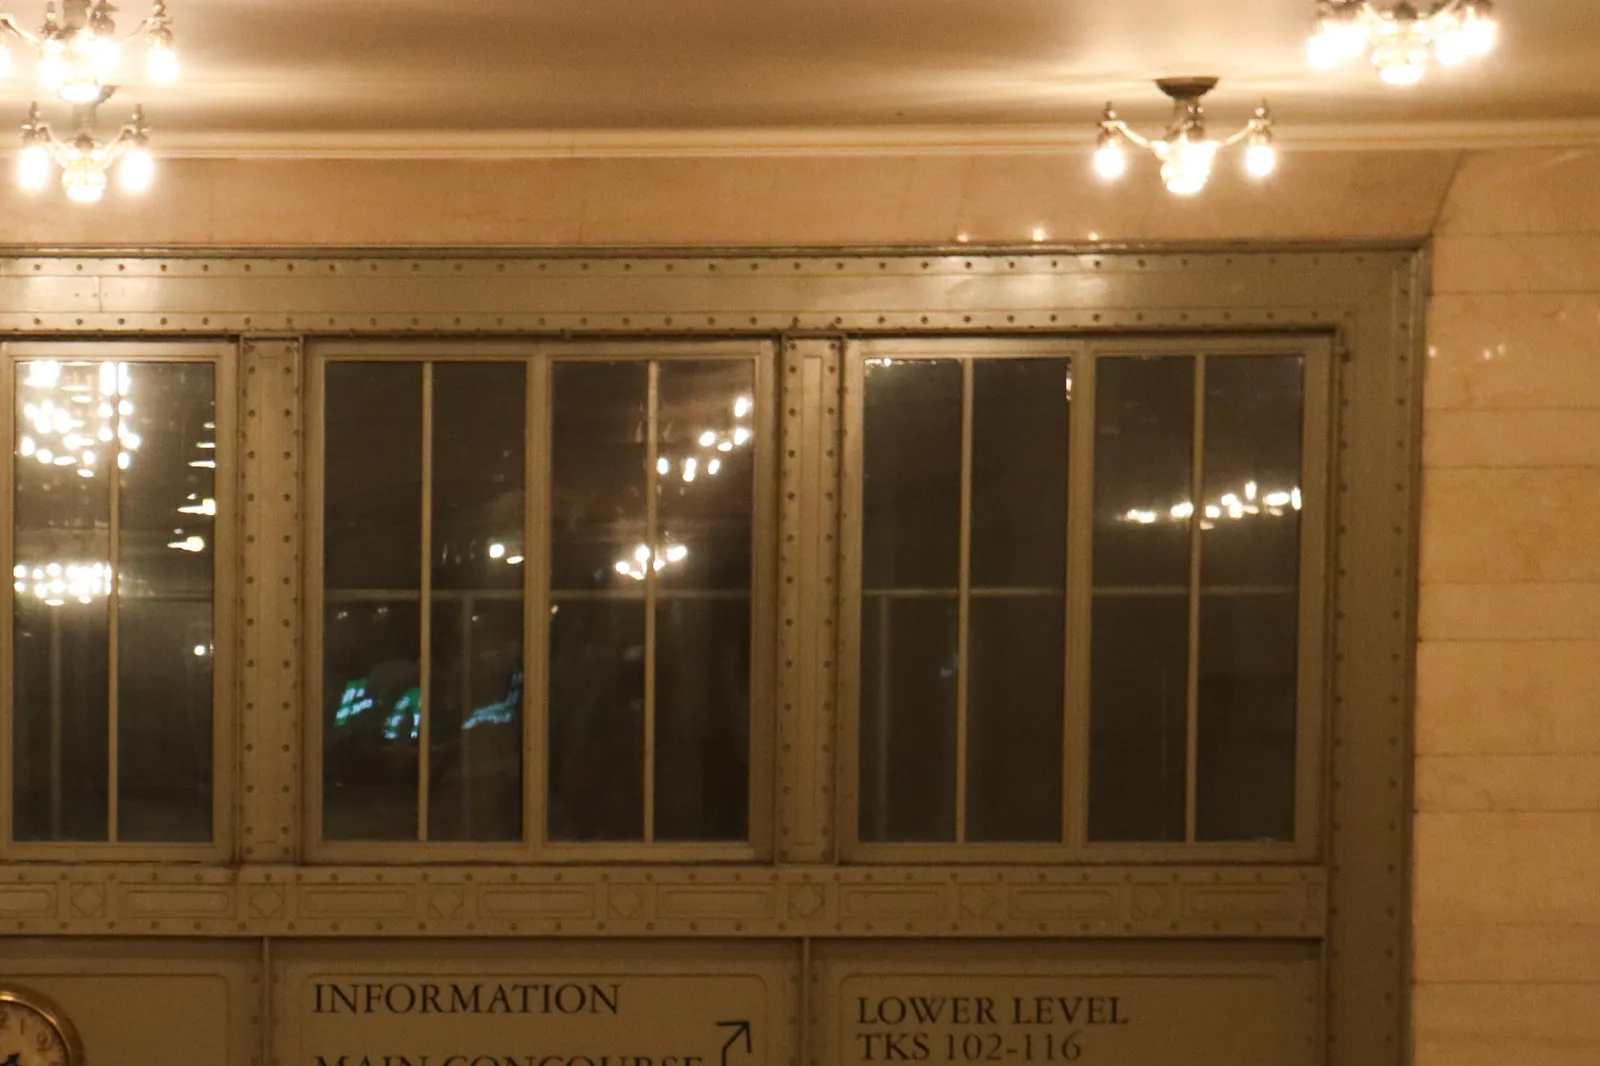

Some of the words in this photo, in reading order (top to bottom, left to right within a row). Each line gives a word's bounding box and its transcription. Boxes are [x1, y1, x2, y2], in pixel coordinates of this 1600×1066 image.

[312, 982, 615, 1014] INFORMATION
[857, 996, 998, 1026] LOWER
[1010, 996, 1130, 1026] LEVEL
[856, 1031, 931, 1061] TKS
[945, 1031, 1083, 1061] 102-116
